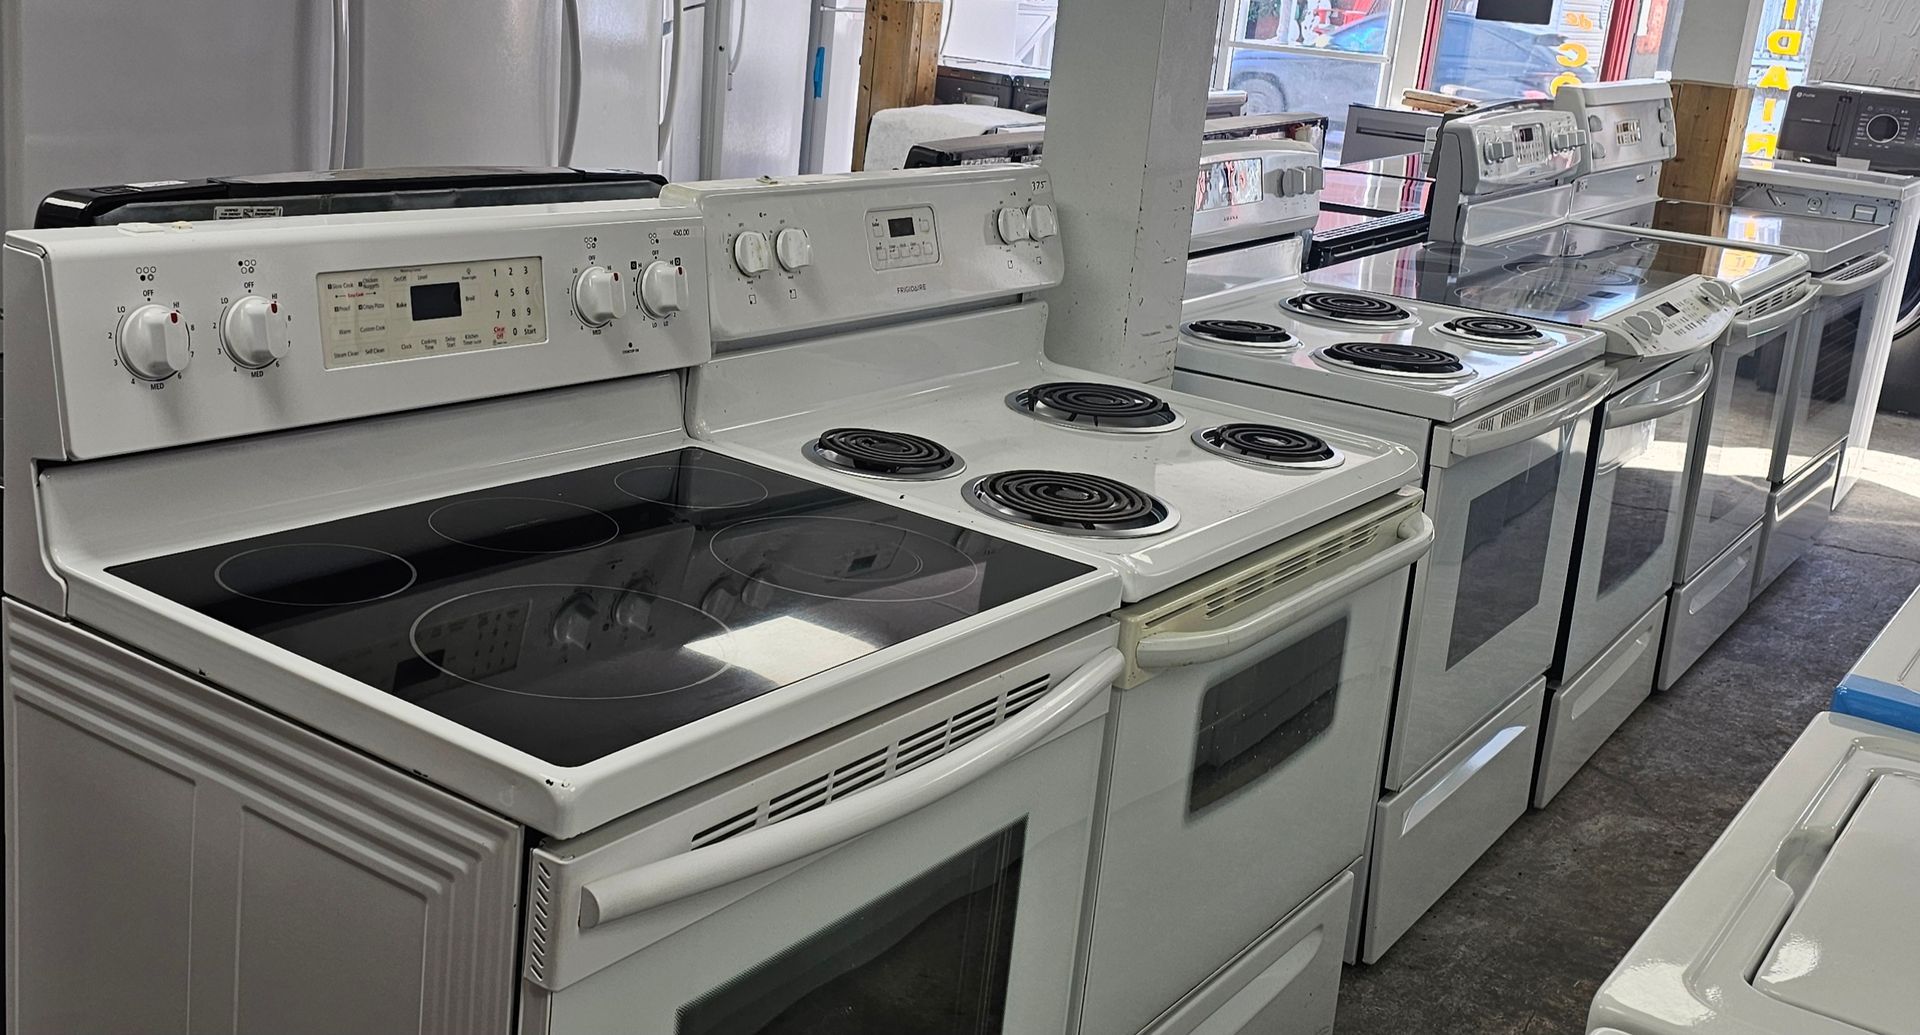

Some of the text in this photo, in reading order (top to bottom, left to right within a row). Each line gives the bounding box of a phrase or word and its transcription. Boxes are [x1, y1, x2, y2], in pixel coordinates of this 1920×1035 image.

[1031, 181, 1047, 191] 375
[508, 267, 513, 276] 2
[523, 266, 528, 275] 3
[494, 286, 530, 298] 4 5 6
[896, 283, 927, 294] FRIGIDAIRE
[511, 308, 516, 317] 8
[526, 307, 531, 316] 9
[512, 328, 518, 336] 0
[524, 328, 537, 336] Start
[251, 370, 264, 378] MED
[150, 382, 165, 391] MED
